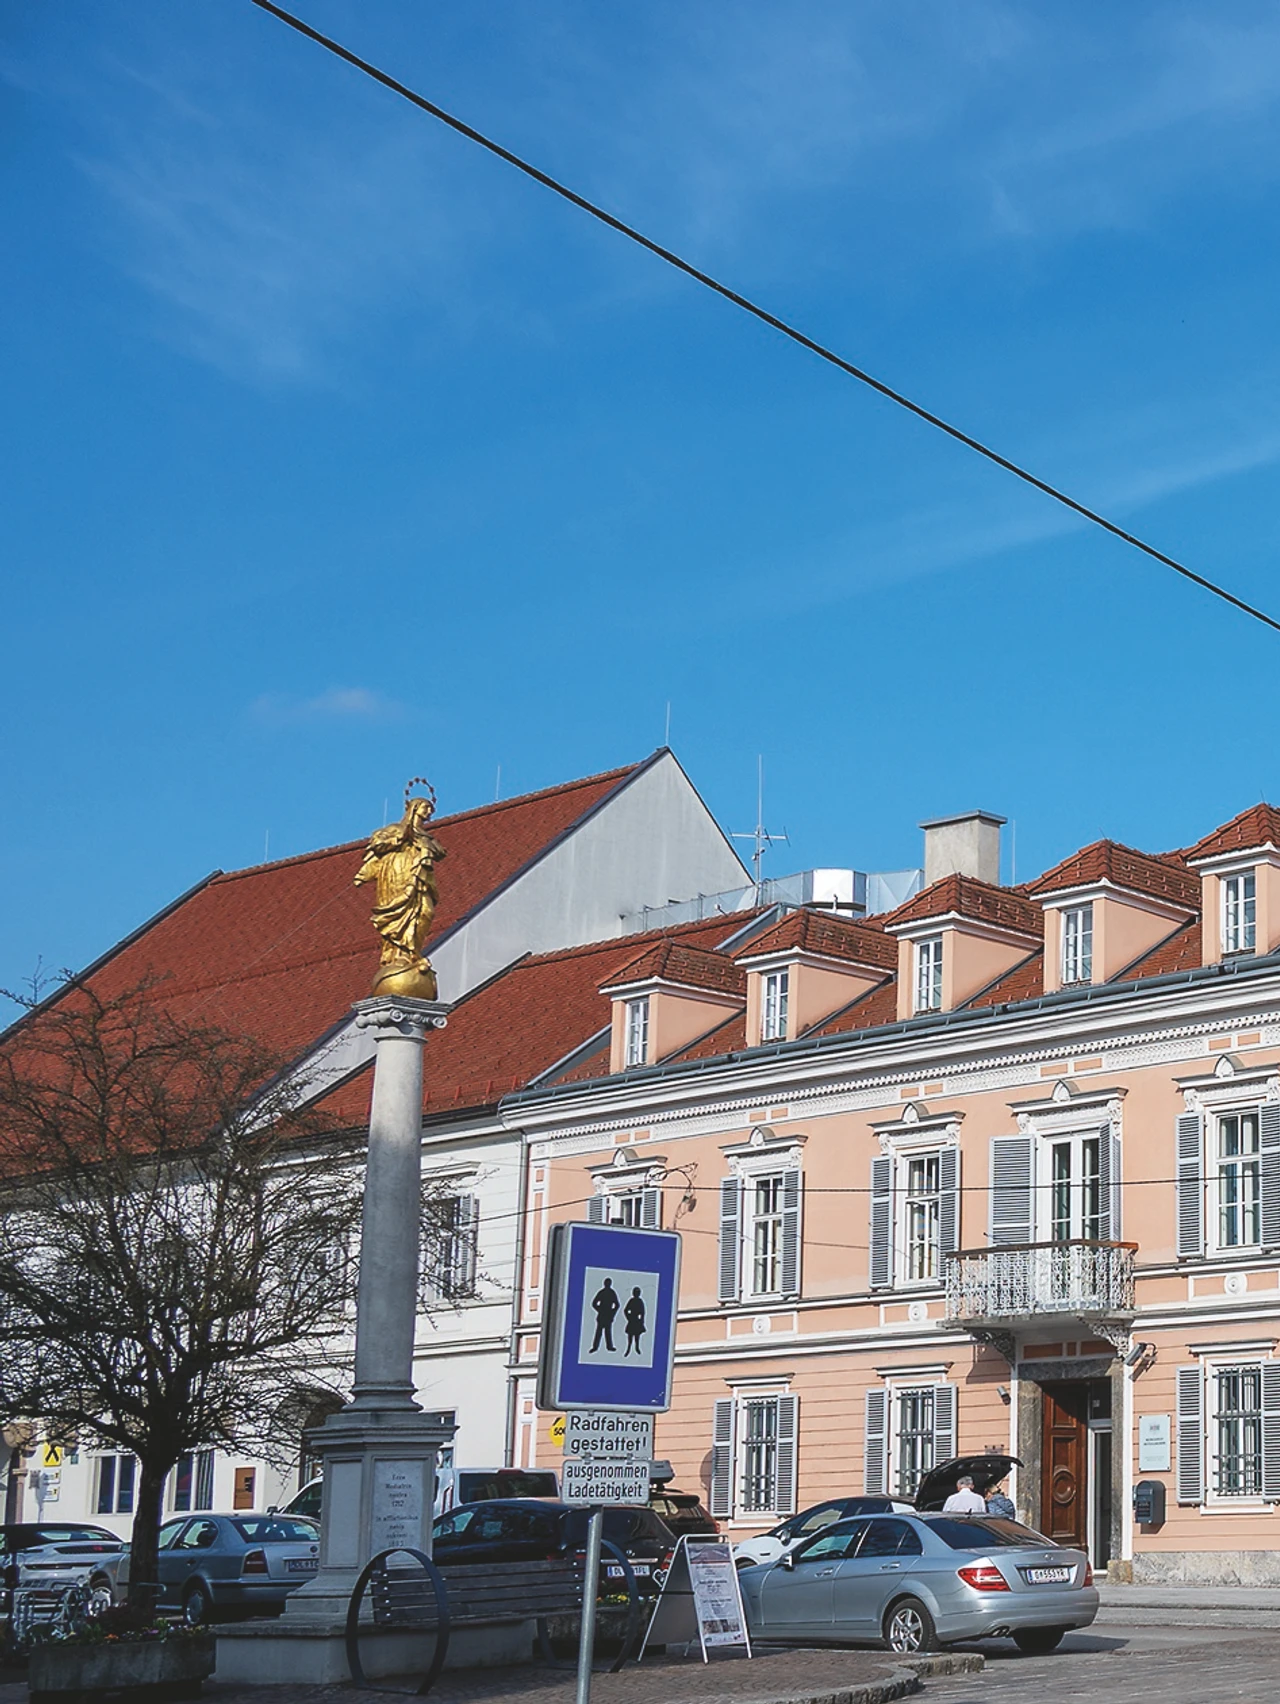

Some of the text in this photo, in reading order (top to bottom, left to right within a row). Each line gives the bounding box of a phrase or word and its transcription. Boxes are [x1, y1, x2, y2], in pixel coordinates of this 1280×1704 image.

[570, 1415, 649, 1432] Radfahren
[566, 1465, 648, 1482] ausgenommen
[568, 1481, 643, 1501] Ladetätigkeit
